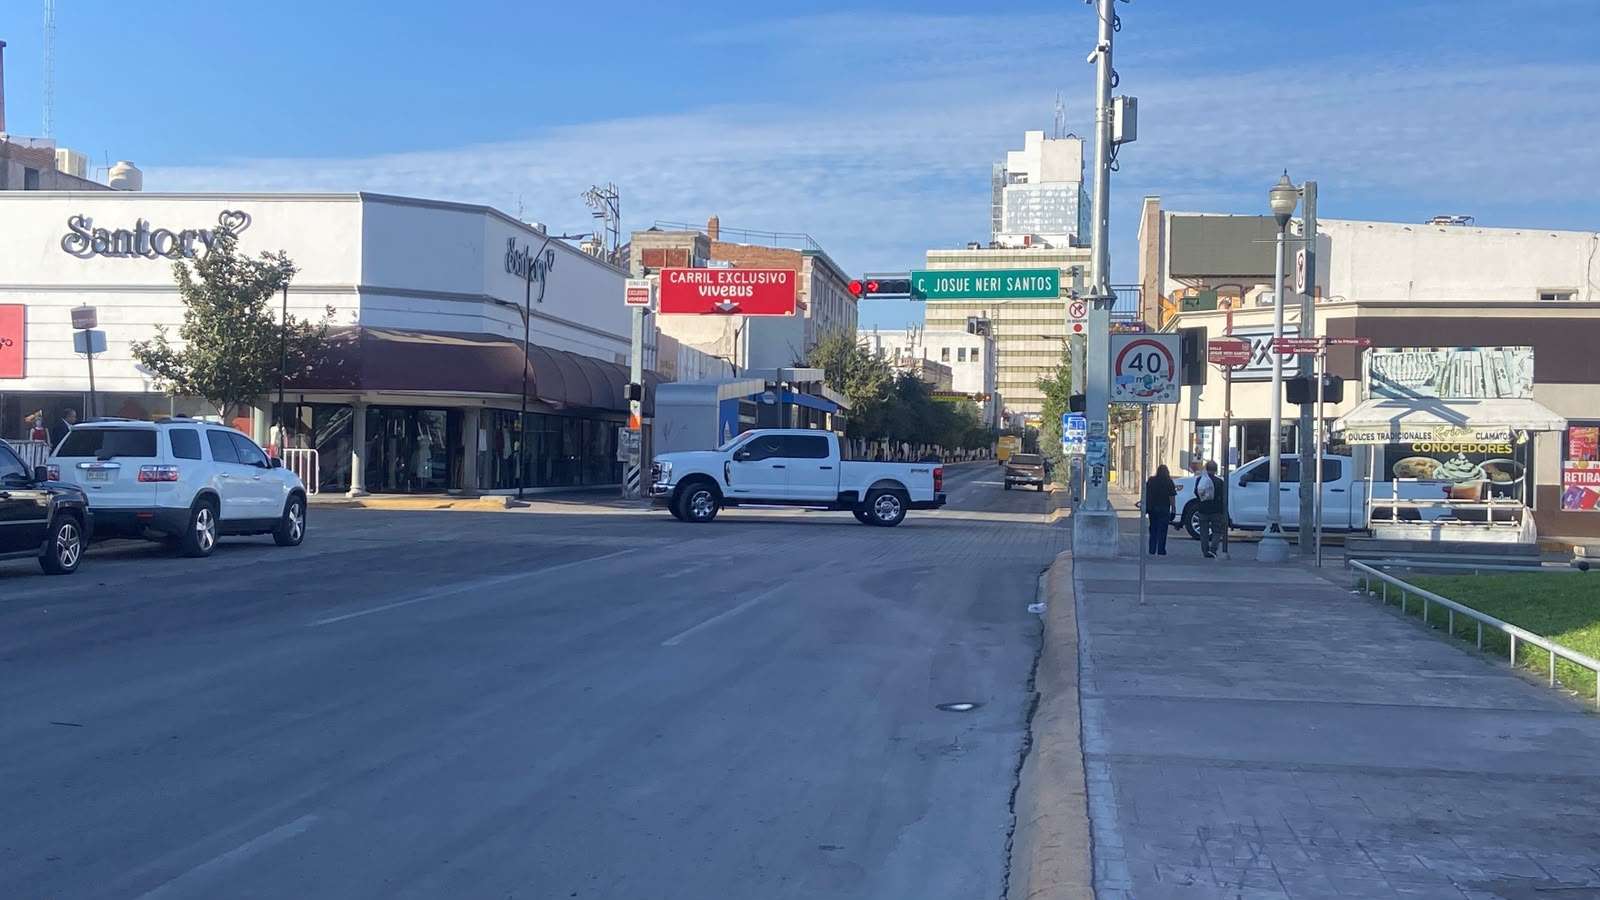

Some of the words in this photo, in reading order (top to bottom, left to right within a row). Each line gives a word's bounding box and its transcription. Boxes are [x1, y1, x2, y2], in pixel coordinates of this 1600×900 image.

[61, 212, 226, 259] Santory
[670, 271, 713, 284] CARRIL
[718, 271, 787, 284] EXCLUSIVO
[918, 278, 928, 293] C.
[933, 277, 970, 292] JOSUE
[975, 277, 1001, 292] NERI
[1007, 276, 1052, 291] SANTOS
[1127, 352, 1162, 374] 40
[1348, 432, 1375, 441] DULCES
[1377, 432, 1432, 440] TRADICIONALES
[1411, 442, 1513, 455] CONOCEDORES
